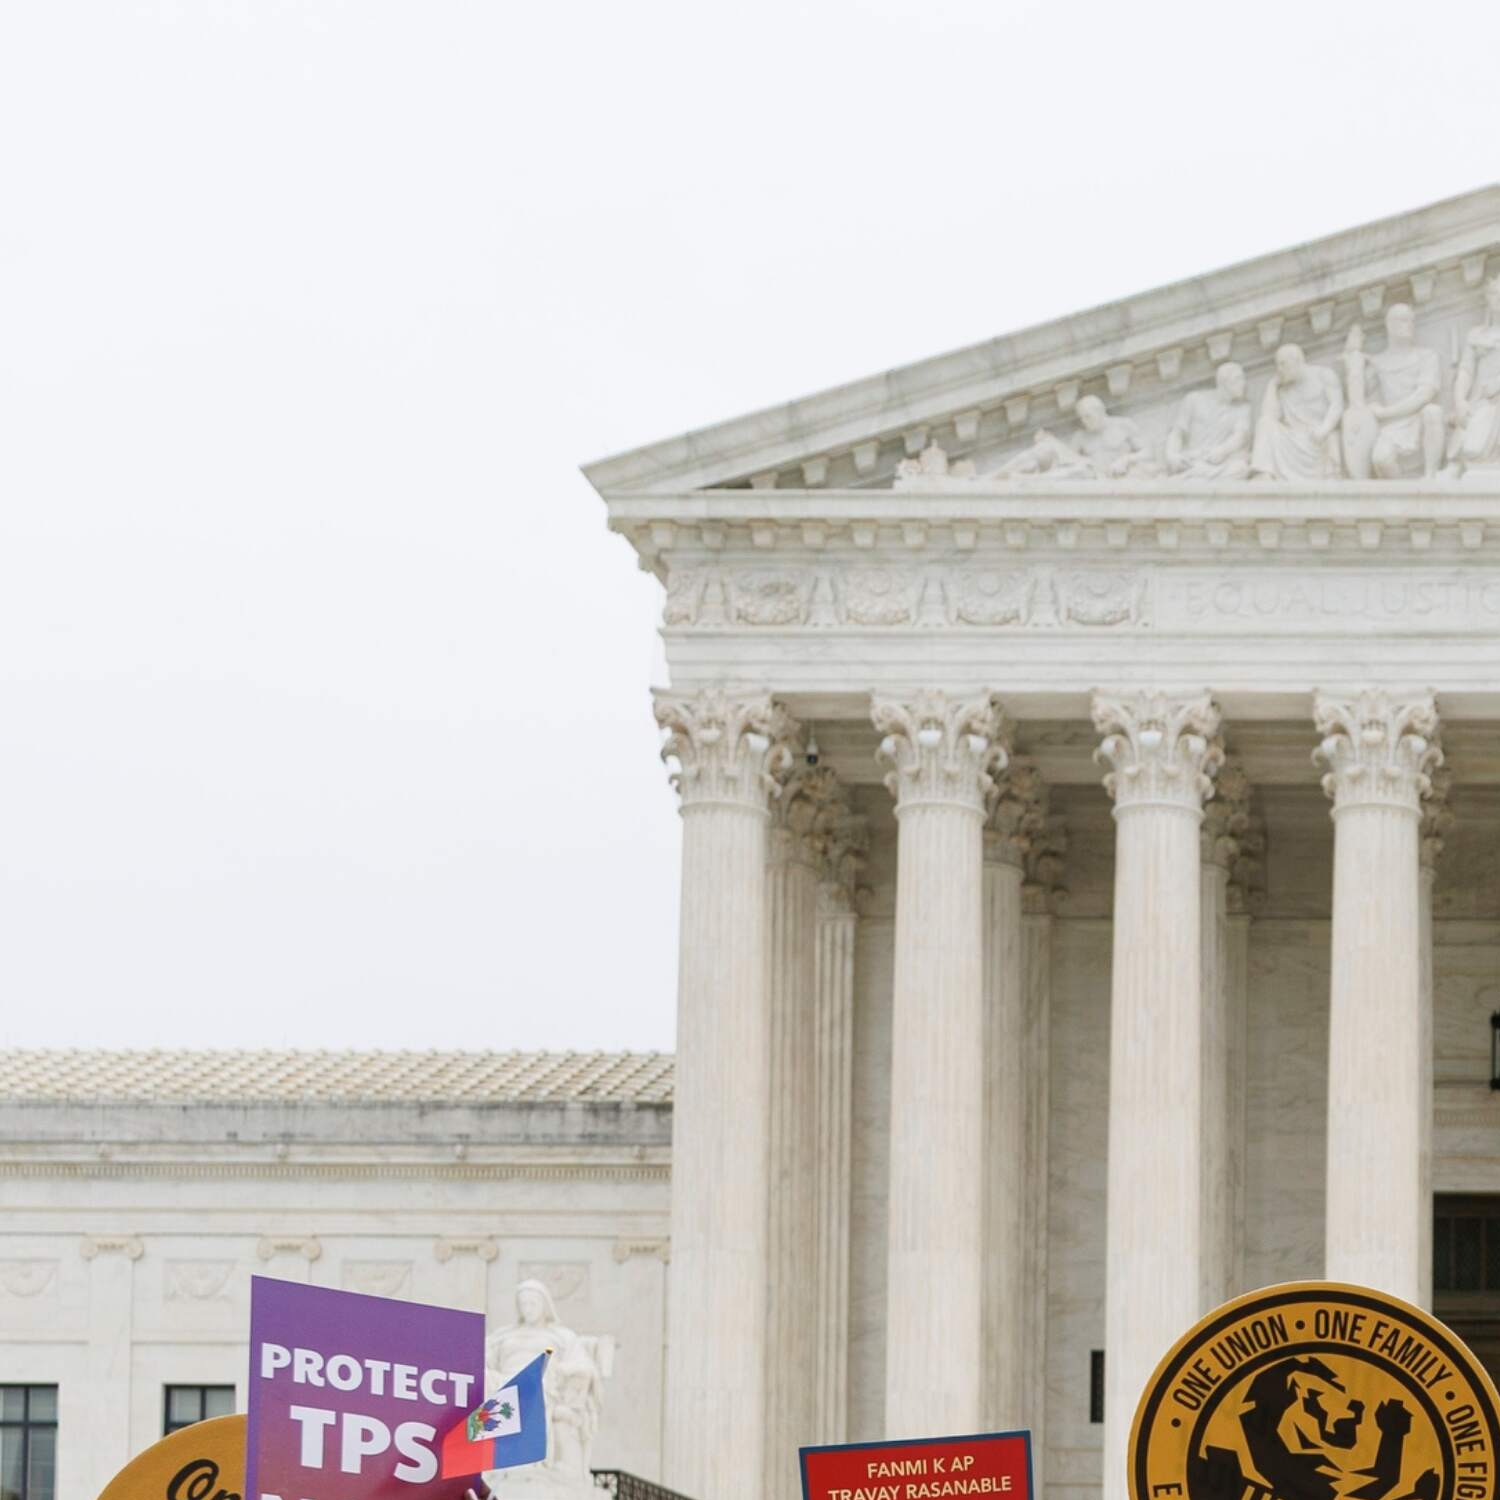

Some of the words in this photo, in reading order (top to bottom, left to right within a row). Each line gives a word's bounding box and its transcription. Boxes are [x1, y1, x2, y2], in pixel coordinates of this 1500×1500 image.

[1184, 580, 1341, 615] EQUAL
[260, 1342, 475, 1408] PROTECT
[1173, 1363, 1221, 1411] ONE
[1211, 1314, 1289, 1376] UNION
[1314, 1308, 1367, 1344] ONE
[1368, 1321, 1453, 1391] FAMILY
[1445, 1404, 1485, 1456] ONE
[290, 1405, 439, 1484] TPS
[867, 1457, 927, 1479] FANMI
[933, 1457, 946, 1475] K
[951, 1455, 975, 1473] AP
[906, 1476, 1012, 1500] RASANABLE
